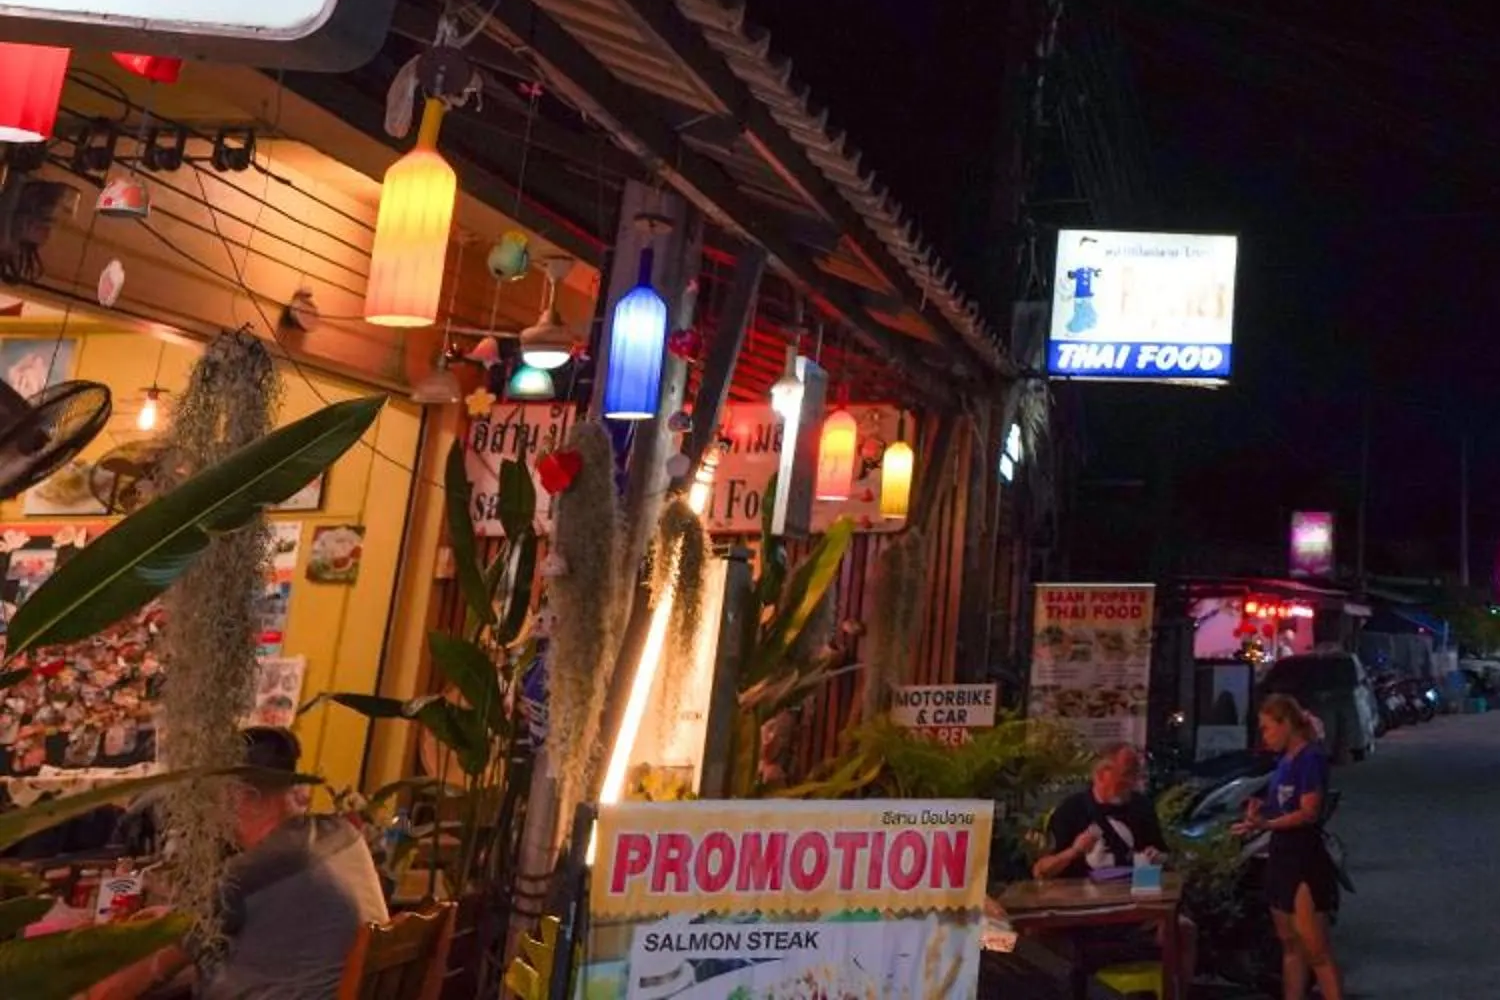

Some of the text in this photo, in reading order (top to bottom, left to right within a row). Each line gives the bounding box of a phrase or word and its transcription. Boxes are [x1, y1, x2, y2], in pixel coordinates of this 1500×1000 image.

[1057, 343, 1224, 371] THAI FOOD
[1046, 605, 1142, 619] THAI FOOD
[894, 689, 993, 707] MOTORBIKE
[916, 709, 968, 725] & CAR
[610, 829, 970, 893] PROMOTION
[644, 930, 820, 953] SALMON STEAK
